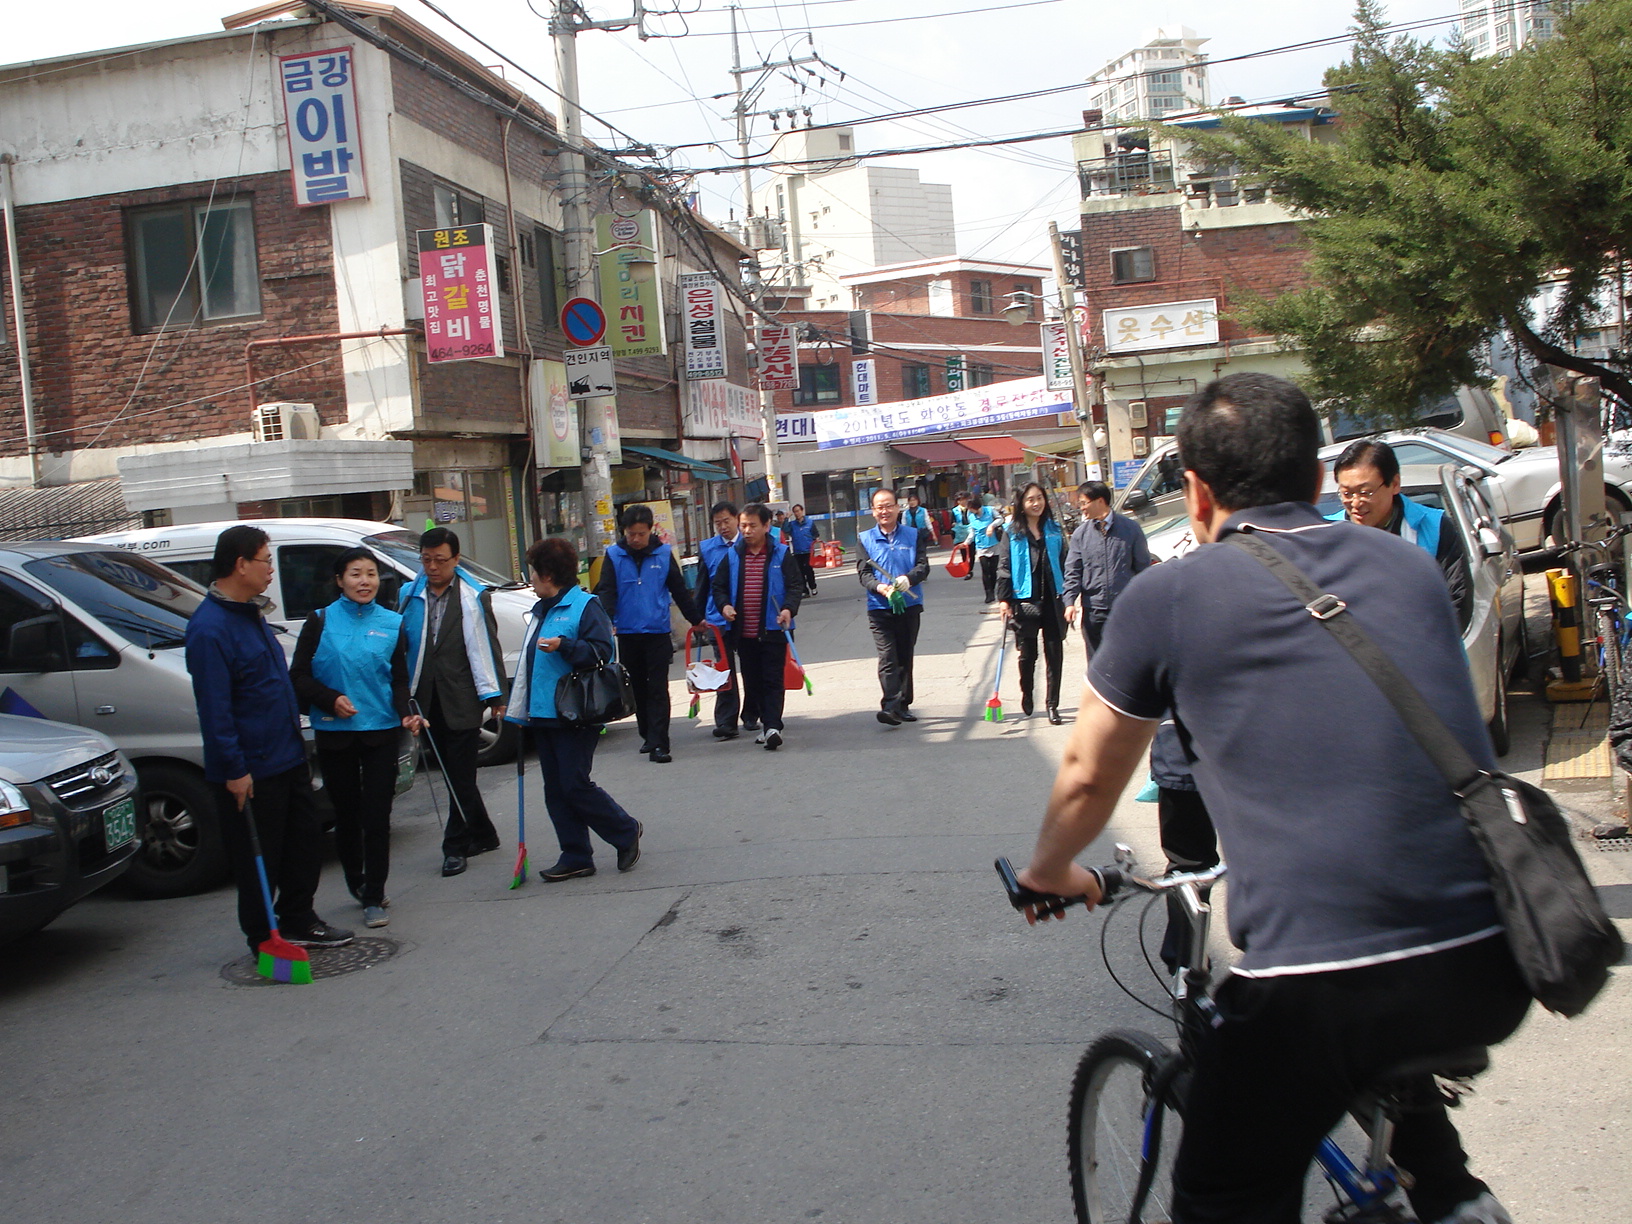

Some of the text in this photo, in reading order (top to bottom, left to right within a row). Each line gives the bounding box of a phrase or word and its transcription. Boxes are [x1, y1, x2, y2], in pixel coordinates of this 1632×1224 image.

[284, 56, 350, 93] 금강
[296, 94, 353, 203] 이발
[434, 227, 470, 248] 원조
[425, 273, 441, 334] 최고맛집
[440, 252, 471, 341] 닭갈비
[475, 268, 491, 329] 춘천명물
[687, 288, 717, 350] 은성철물
[1117, 310, 1206, 343] 옷수선
[431, 343, 494, 359] 464-9264
[566, 352, 610, 367] 견인지역
[760, 328, 795, 380] 부동산
[856, 361, 871, 403] 현대마트
[843, 410, 911, 433] 2011년도
[920, 401, 967, 421] 화양동
[106, 813, 136, 847] 3543
